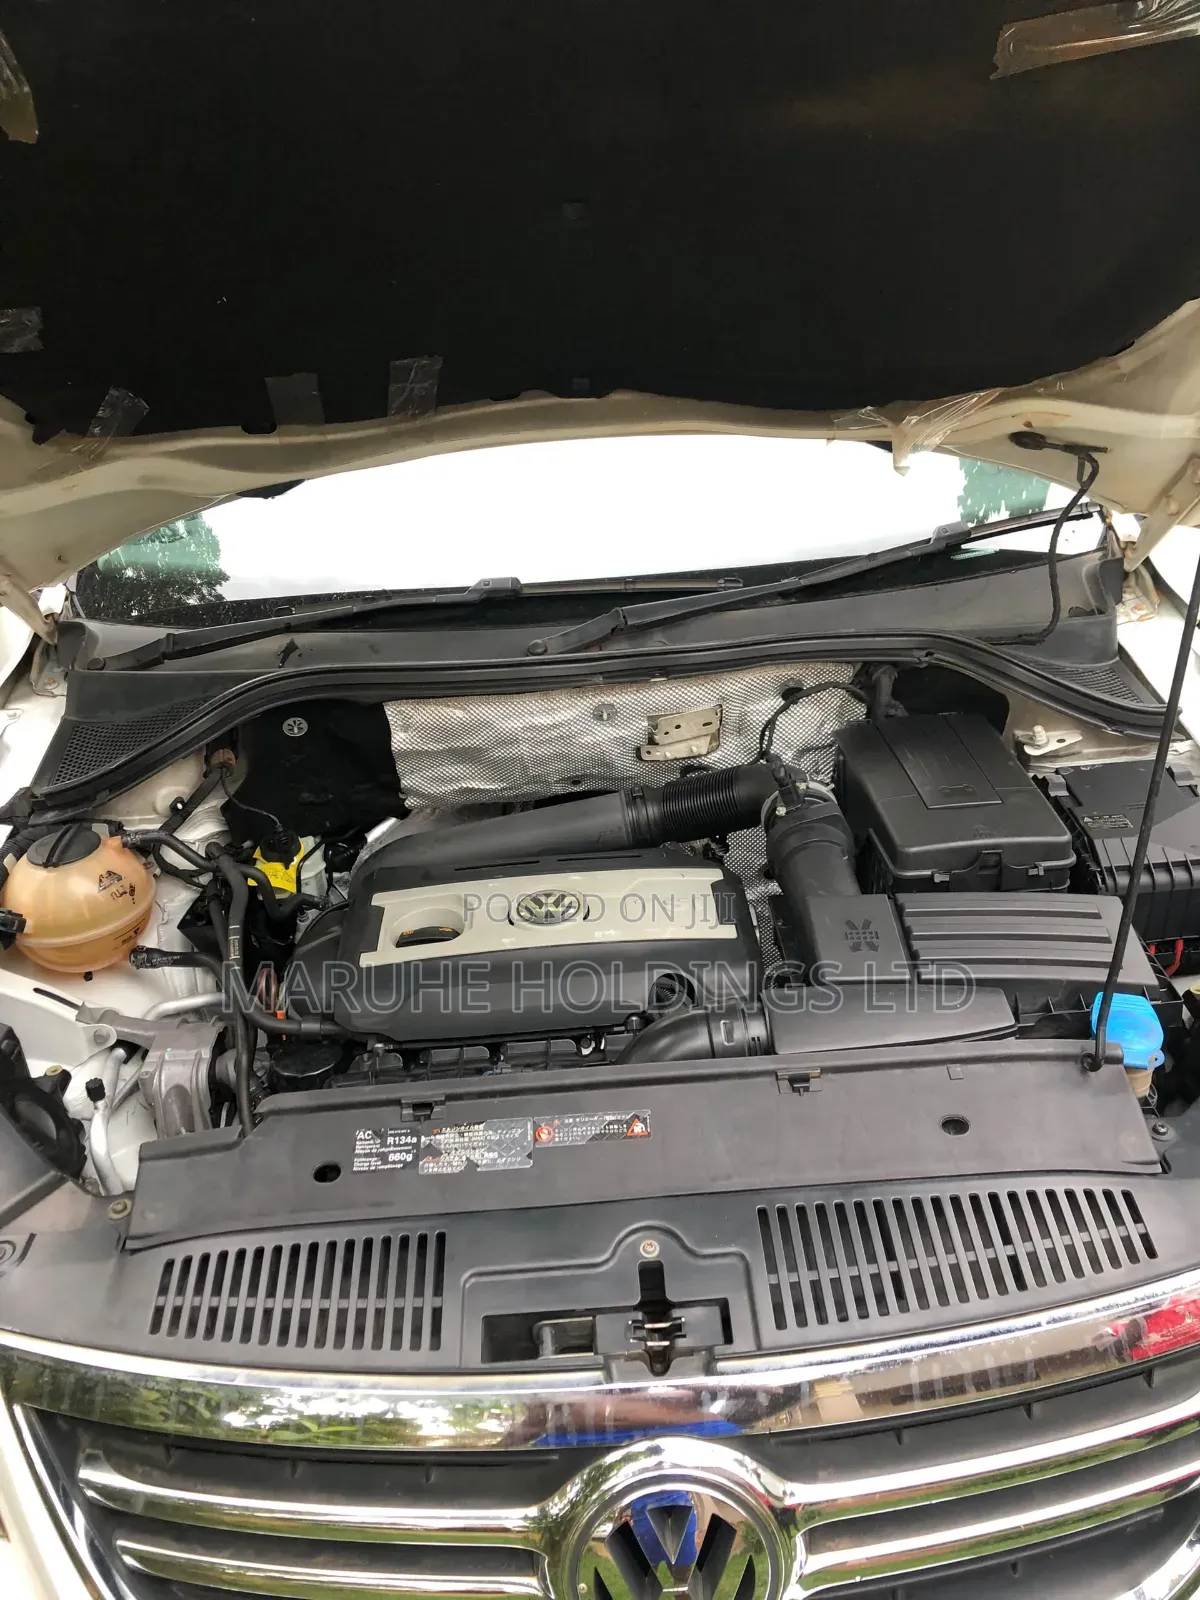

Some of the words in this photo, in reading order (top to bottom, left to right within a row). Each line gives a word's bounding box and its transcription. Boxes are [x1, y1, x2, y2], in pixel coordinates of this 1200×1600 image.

[356, 1130, 372, 1139] AC
[387, 1136, 417, 1146] R134a
[388, 1152, 413, 1162] 660g
